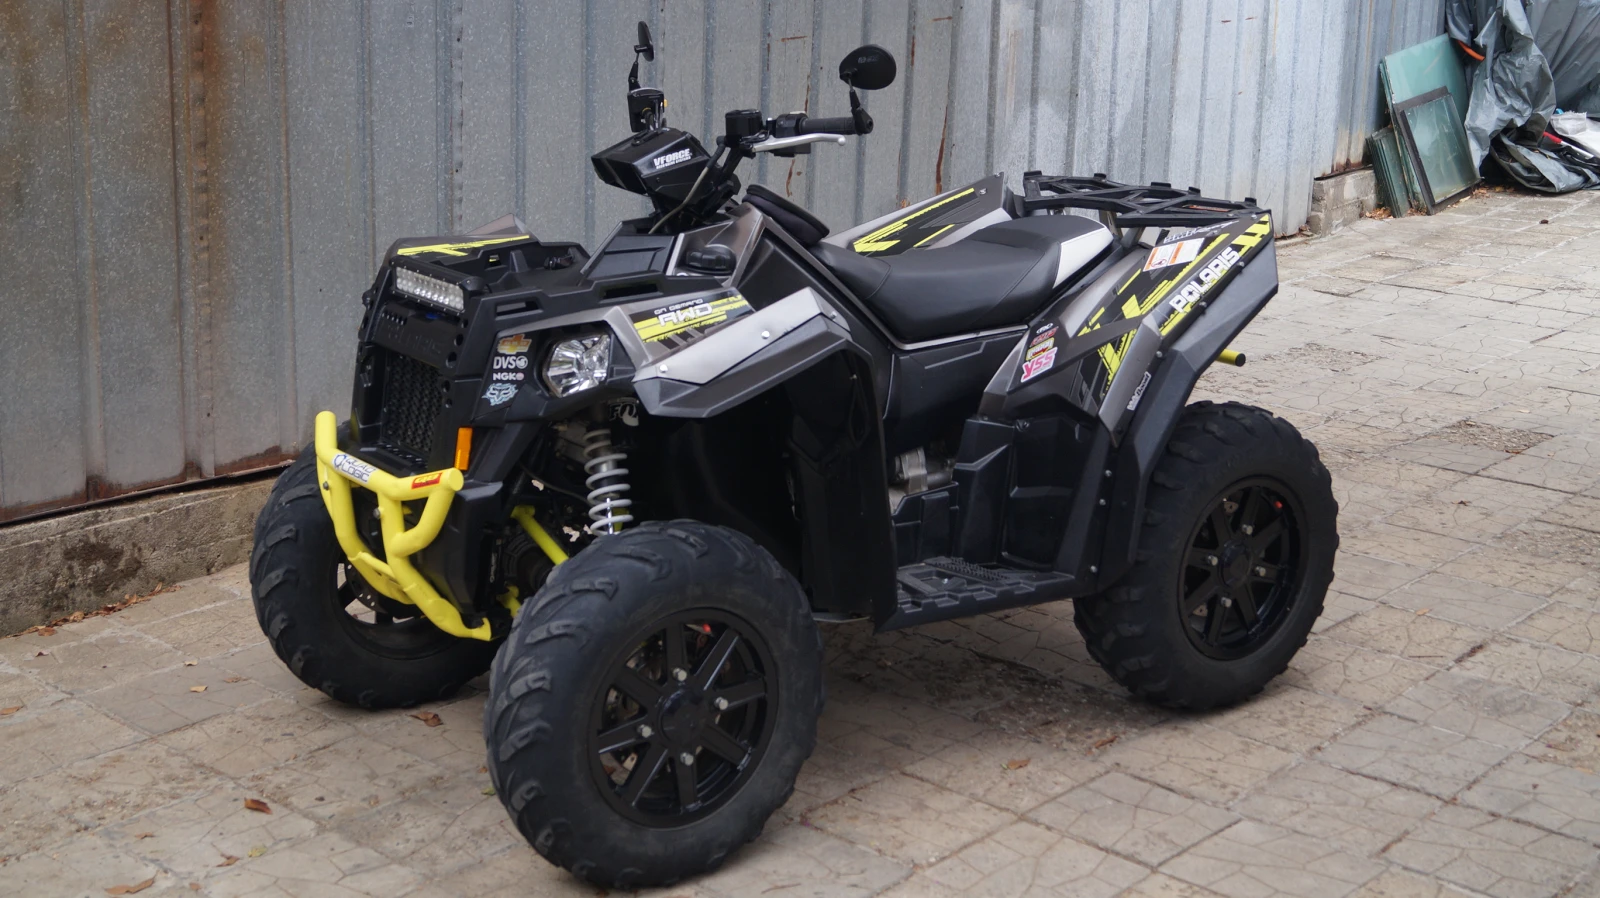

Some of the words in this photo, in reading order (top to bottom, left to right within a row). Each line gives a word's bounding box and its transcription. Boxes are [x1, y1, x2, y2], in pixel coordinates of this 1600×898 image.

[653, 148, 691, 166] VFORCE
[1169, 246, 1241, 313] POLARIS
[658, 302, 713, 326] AWD
[492, 356, 517, 369] DVS
[1022, 349, 1057, 380] YSS
[492, 372, 517, 381] NGK
[341, 463, 372, 483] LOGIC
